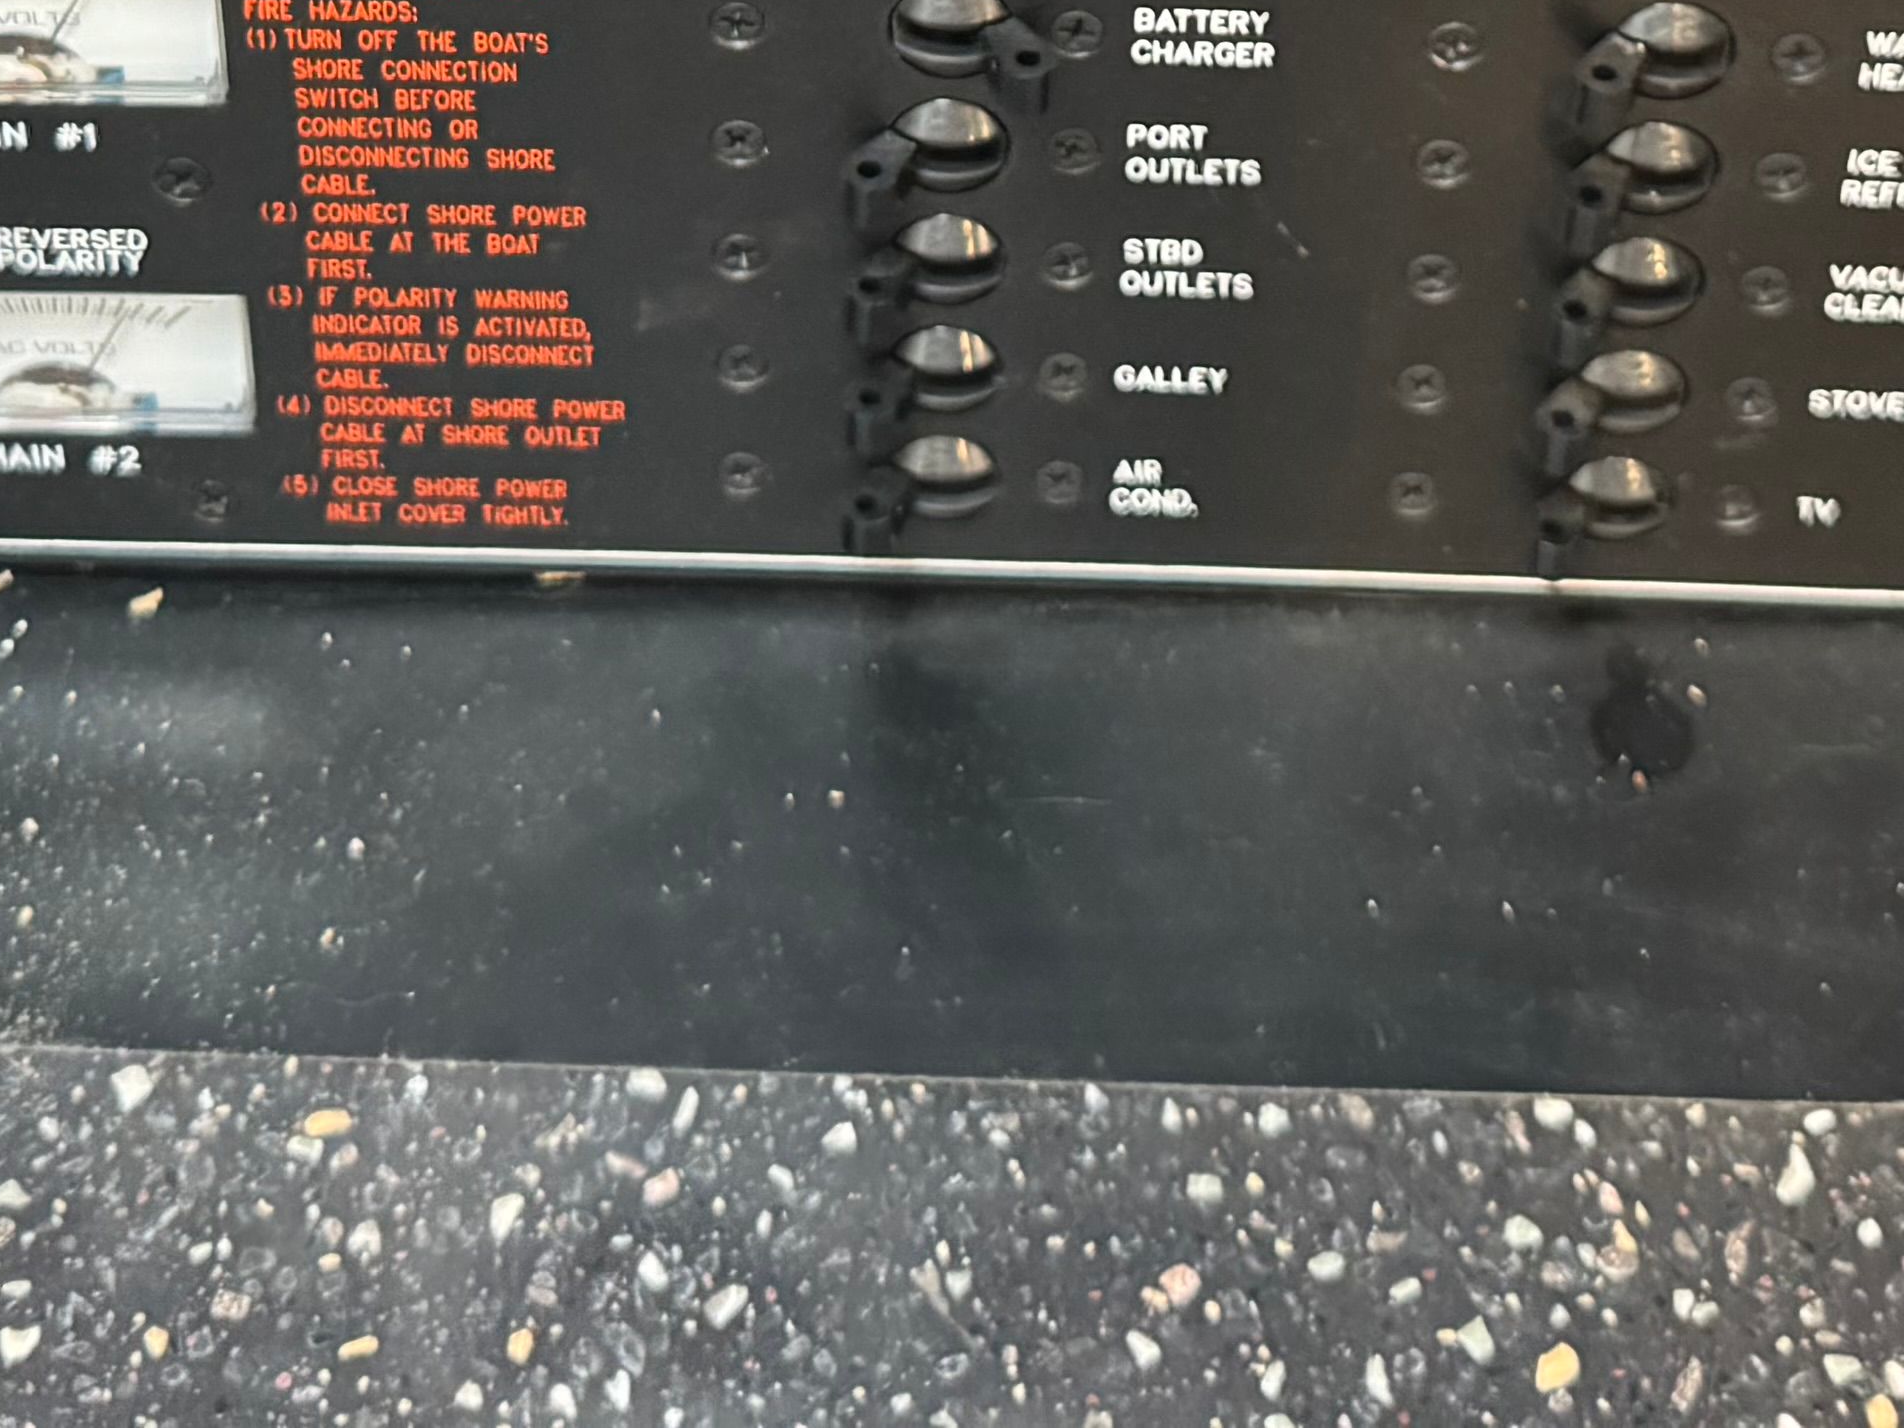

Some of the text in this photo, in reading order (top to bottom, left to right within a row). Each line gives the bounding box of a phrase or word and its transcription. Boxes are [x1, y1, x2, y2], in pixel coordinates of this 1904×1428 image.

[308, 0, 418, 25] HAZARDS:
[1133, 6, 1270, 36] BATTERY
[246, 27, 550, 56] (1) TURN OFF THE BOAT'S
[1130, 38, 1276, 69] CHARGER
[292, 56, 519, 85] SHORE CONNECTION
[294, 87, 477, 114] SWITCH BEFORE
[55, 121, 97, 151] #1
[1126, 123, 1209, 151] PORT
[1124, 155, 1262, 186] OUTLETS
[1846, 148, 1903, 178] ICE
[260, 201, 587, 230] (2) CONNECT SHORE POWER
[1123, 237, 1204, 267] STBD
[1118, 269, 1254, 300] OUTLETS
[1113, 364, 1228, 395] GALLEY
[90, 444, 142, 476] #2
[1112, 458, 1163, 486] AIR
[1108, 486, 1198, 517] COND.
[1797, 495, 1839, 526] TV
